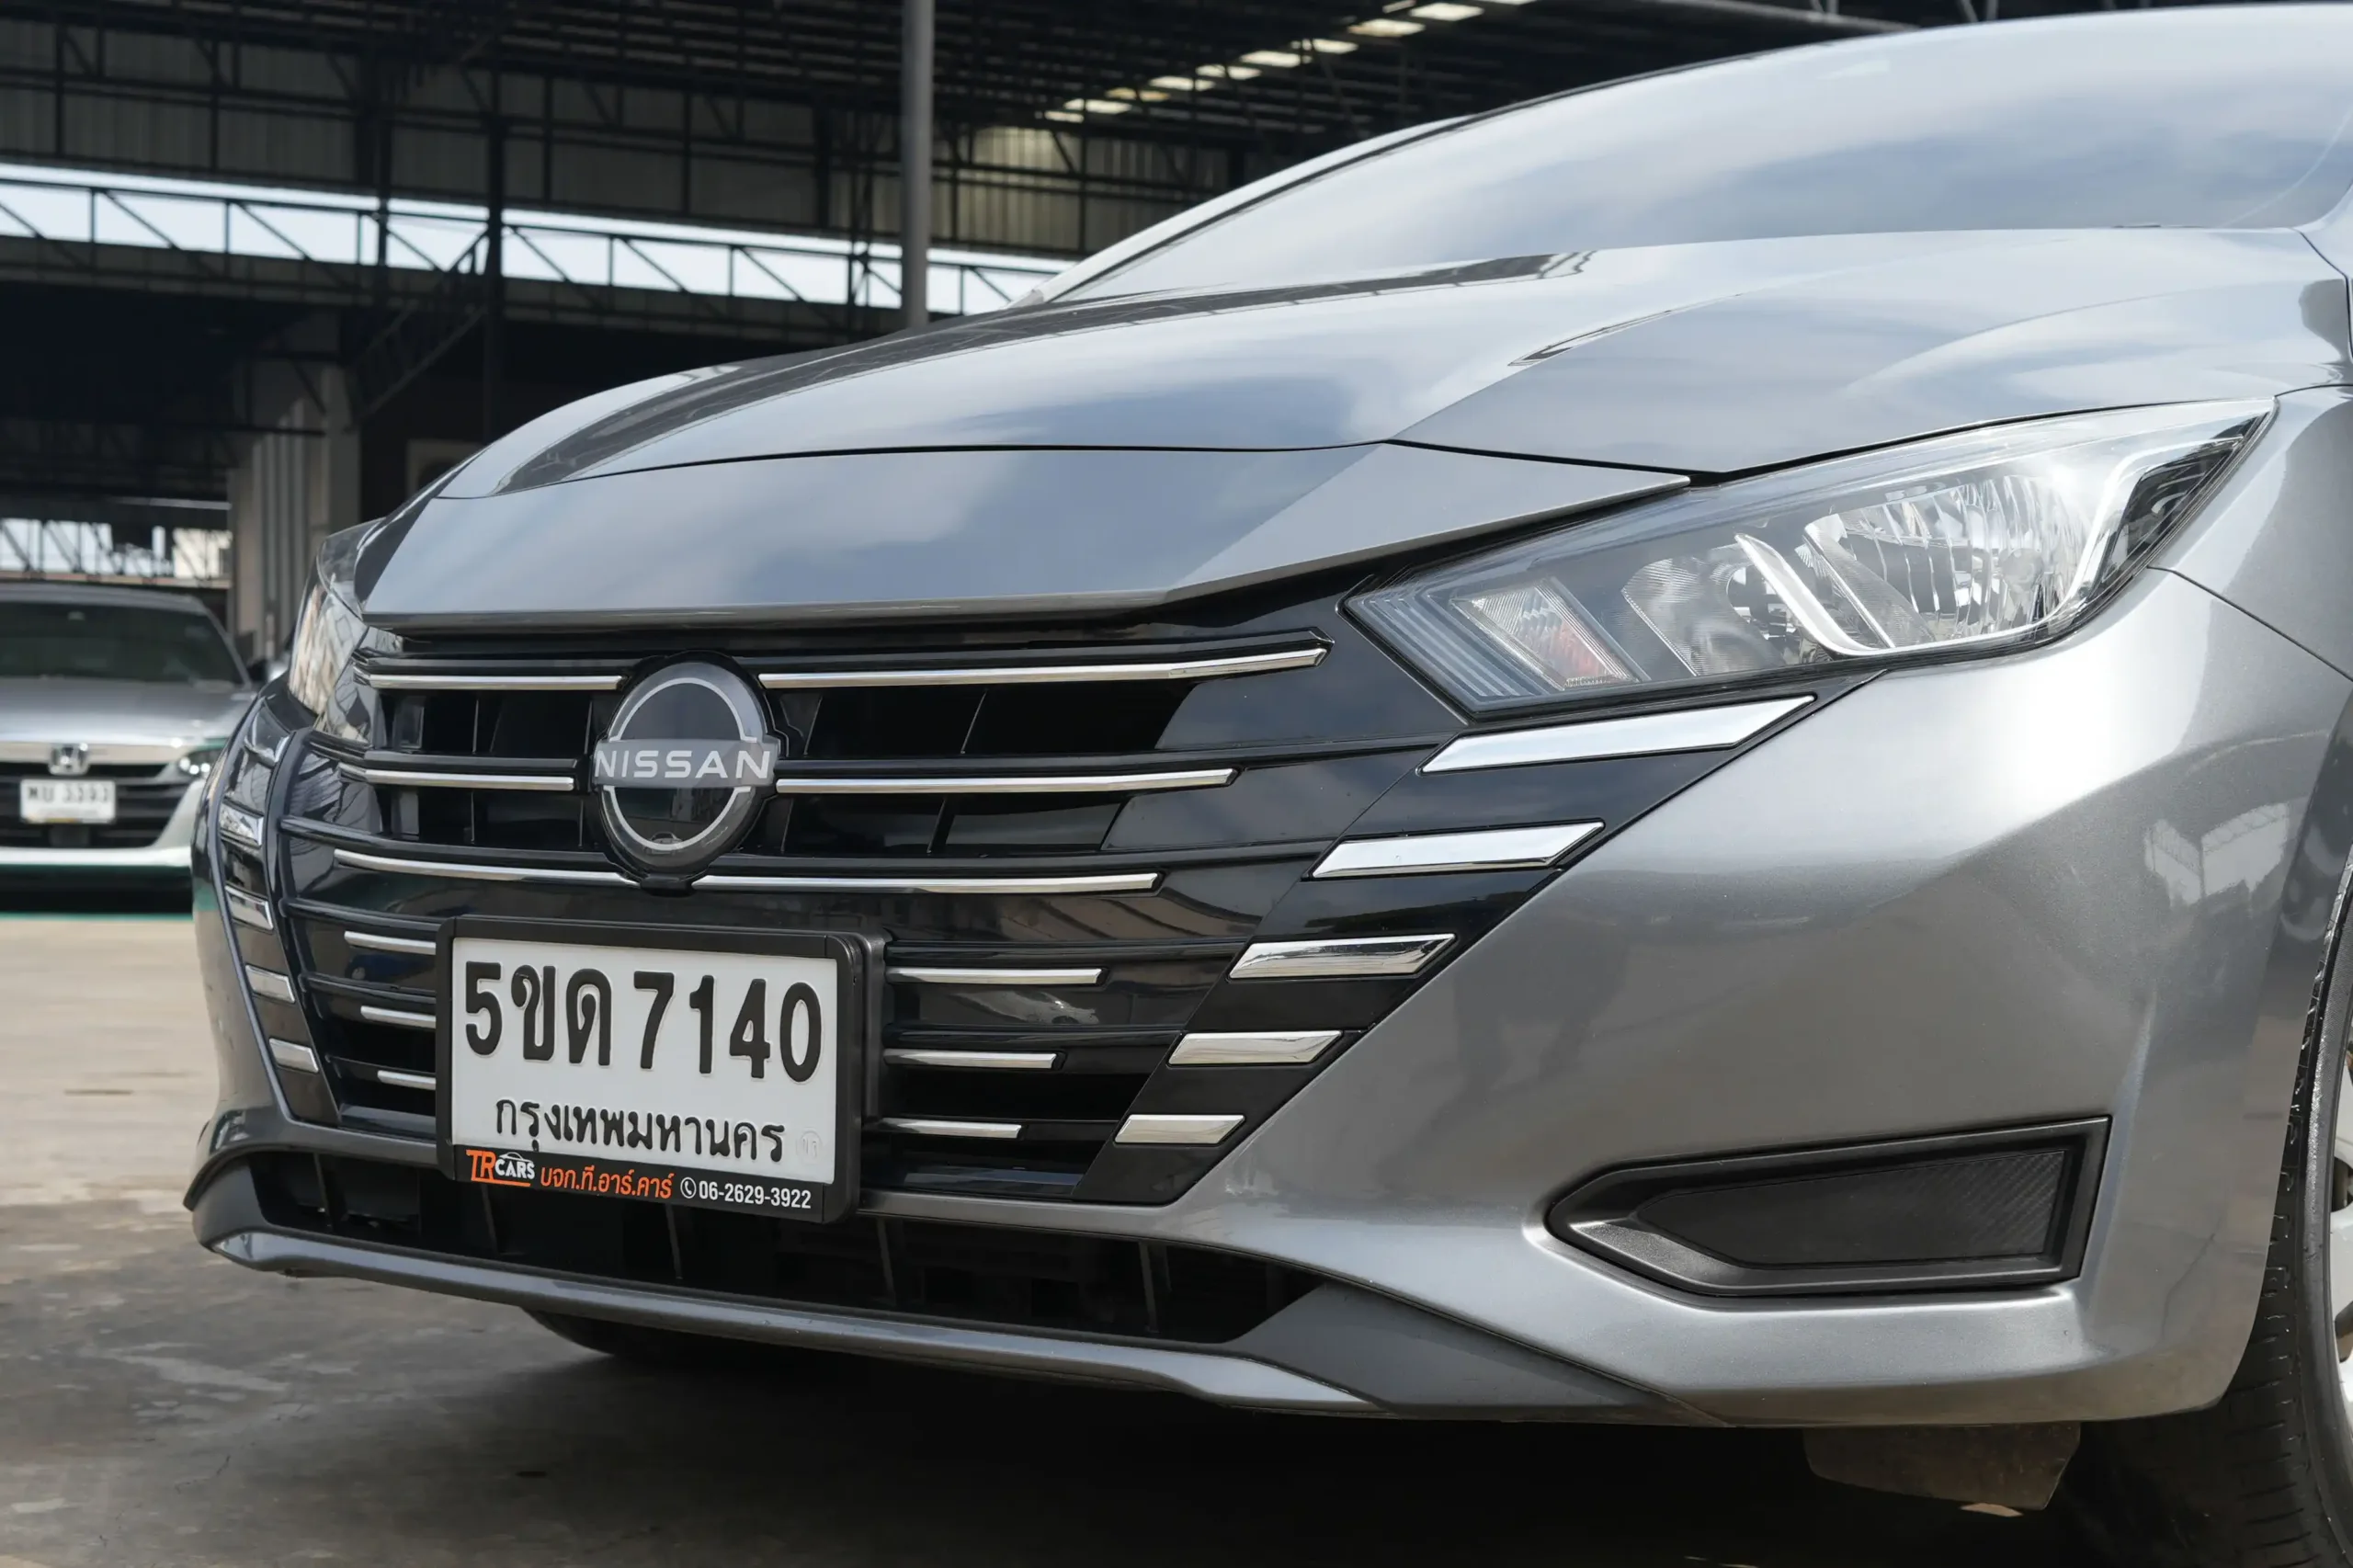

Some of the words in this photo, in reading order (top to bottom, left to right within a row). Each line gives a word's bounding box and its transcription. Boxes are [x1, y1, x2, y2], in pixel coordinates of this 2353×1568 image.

[594, 750, 771, 778] NISSAN
[466, 961, 612, 1066] 5ขด
[633, 971, 823, 1083] 7140
[495, 1099, 786, 1163] กรุงเทพมหานคร
[494, 1159, 535, 1179] CARS
[699, 1180, 812, 1209] 06-2629-3922
